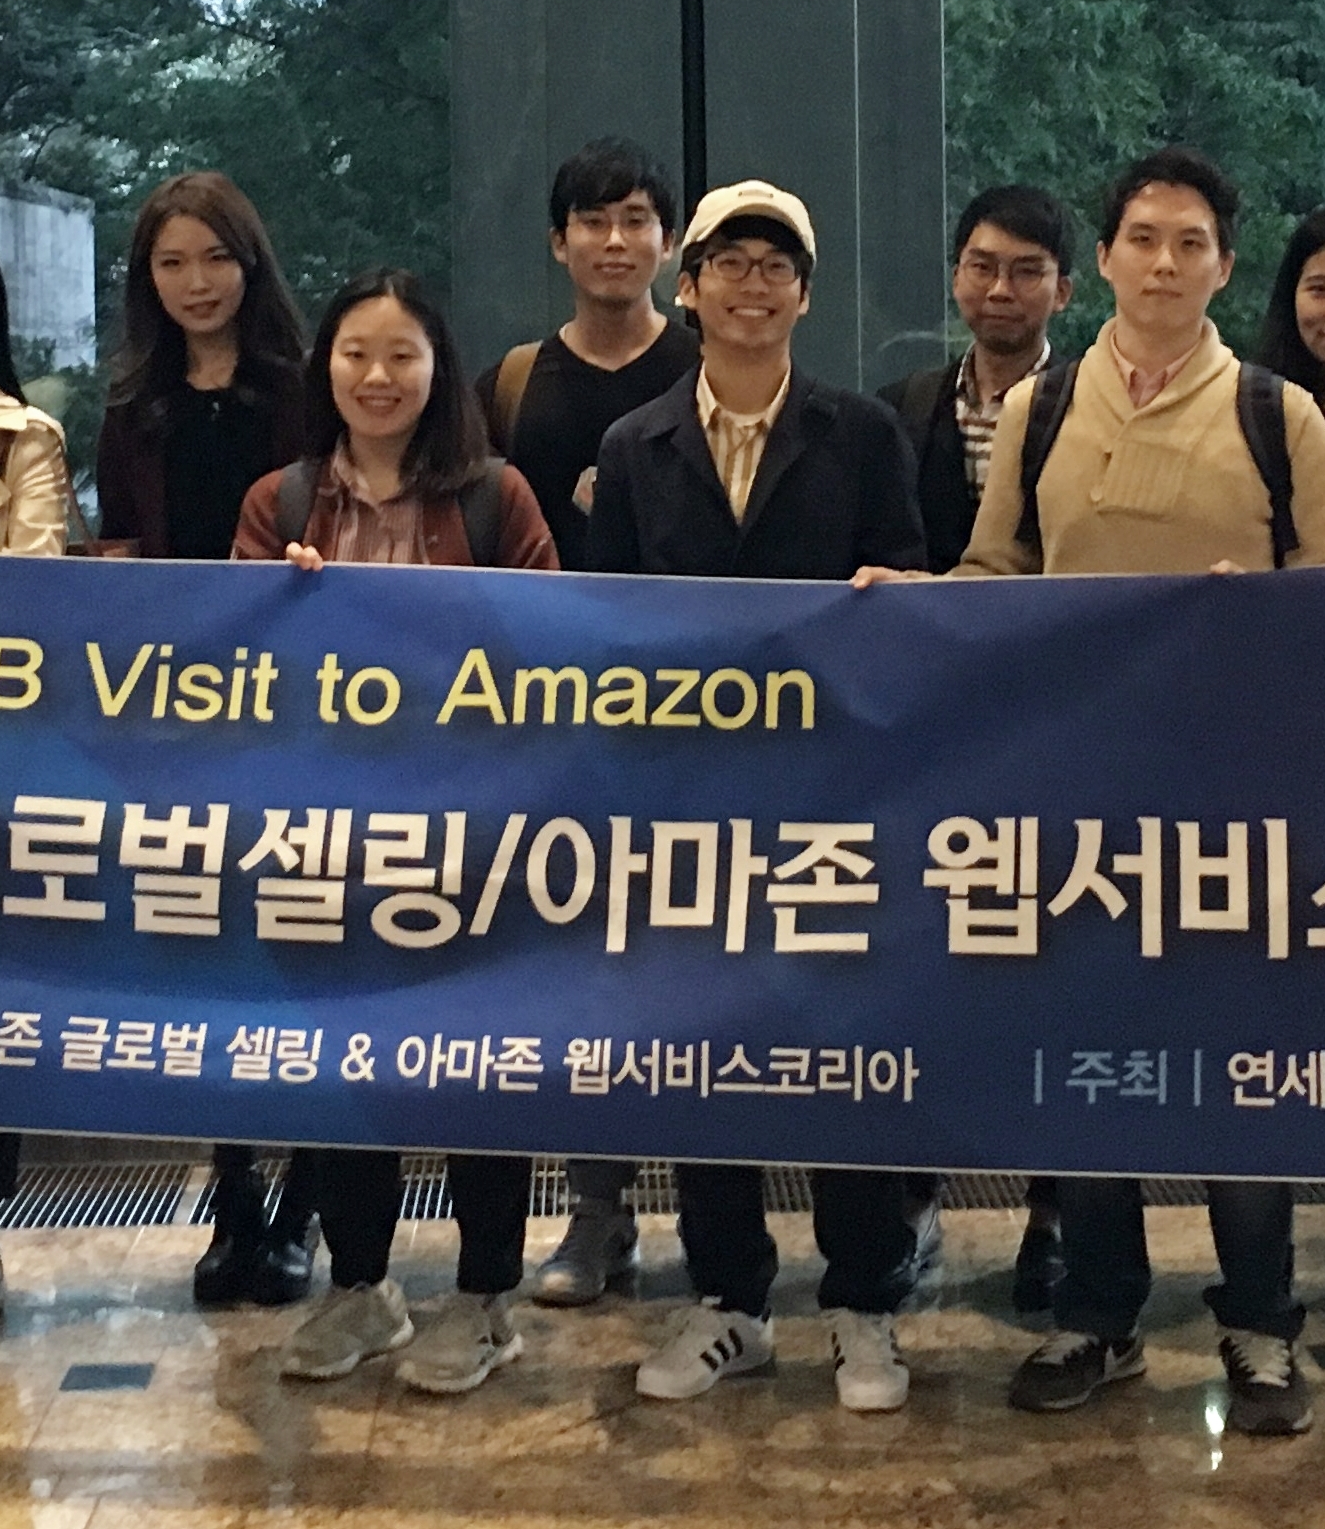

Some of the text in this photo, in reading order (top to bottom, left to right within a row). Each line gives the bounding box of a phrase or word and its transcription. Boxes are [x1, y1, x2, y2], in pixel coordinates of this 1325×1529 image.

[84, 641, 278, 723] Visit
[316, 651, 402, 727] to
[435, 646, 816, 731] Amazon
[59, 1014, 208, 1079] 글로벌
[225, 1024, 323, 1085] 셀링
[339, 1030, 377, 1082] &
[394, 1033, 544, 1094] 아마존
[562, 1038, 920, 1103] 웹서비스코리아
[1064, 1049, 1169, 1107] 주최
